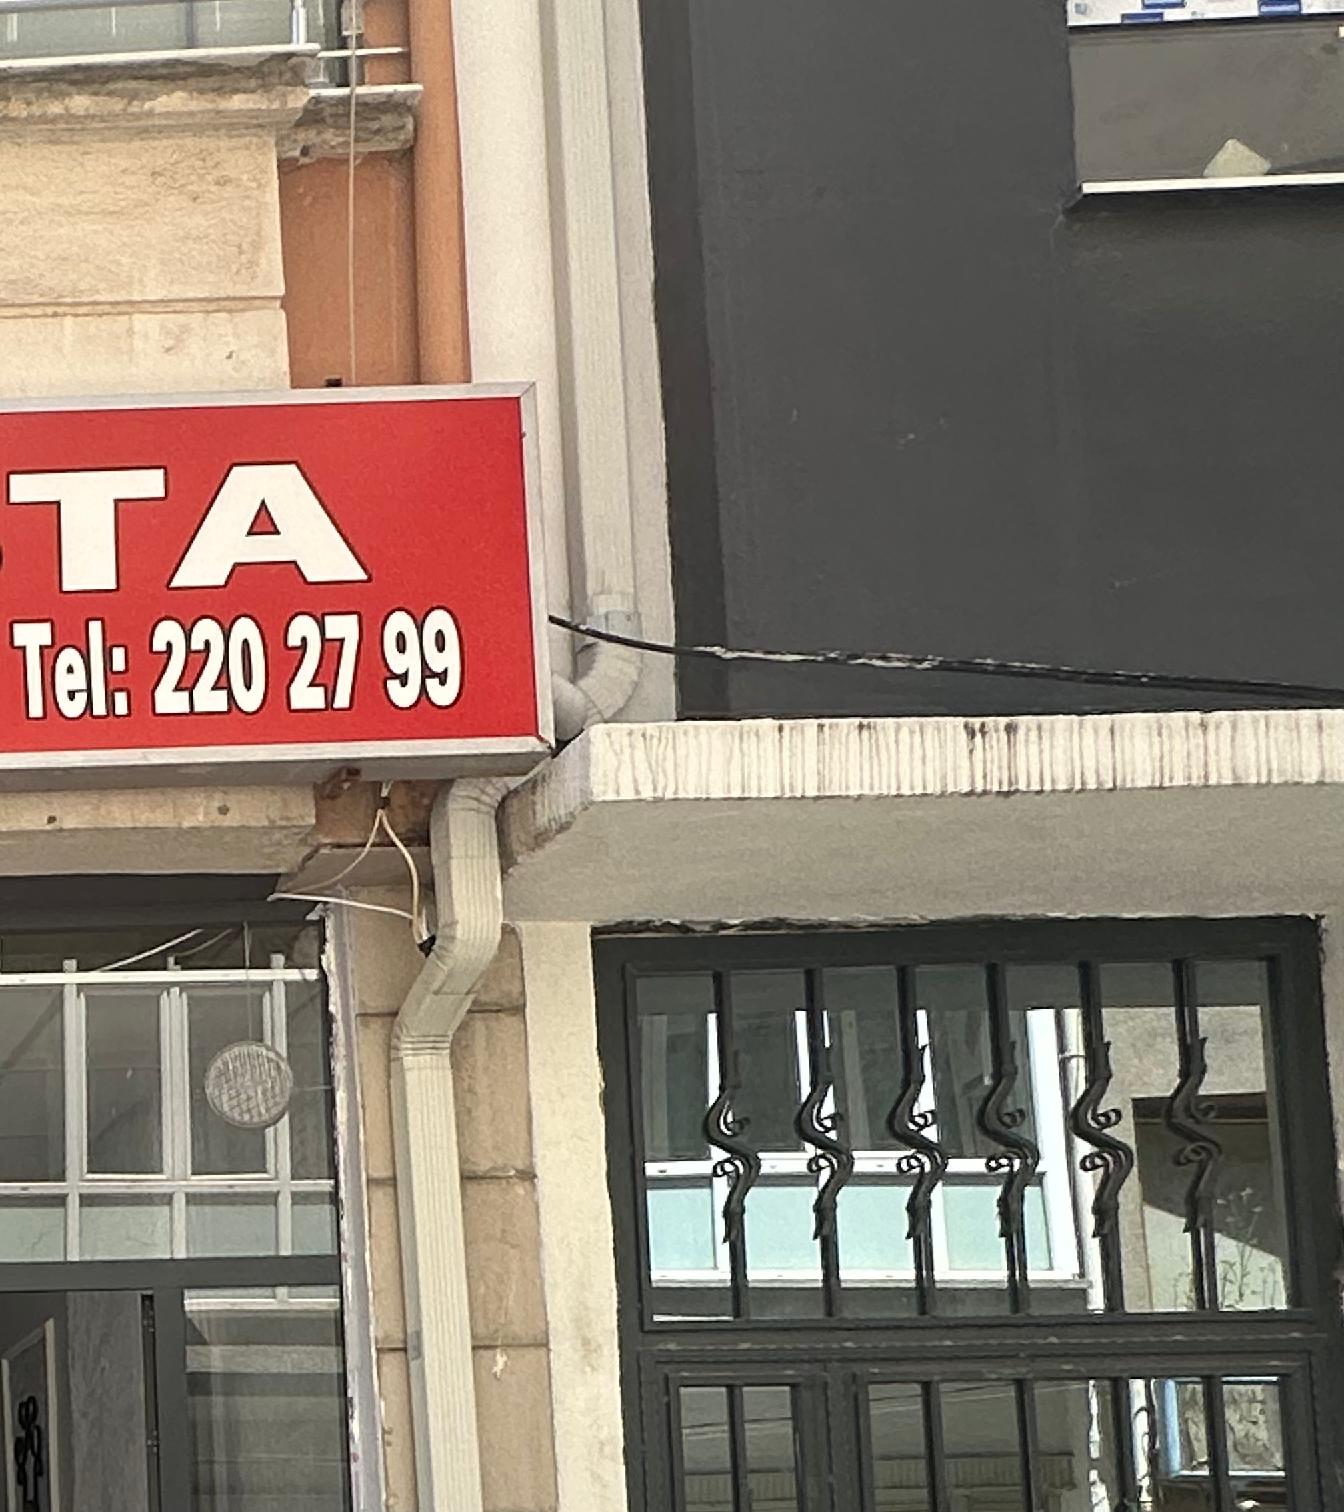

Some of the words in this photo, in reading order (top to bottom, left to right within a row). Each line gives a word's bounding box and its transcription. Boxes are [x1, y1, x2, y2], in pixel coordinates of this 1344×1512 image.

[10, 617, 130, 720] Tel:
[149, 613, 268, 717] 220
[285, 611, 362, 712] 27
[381, 606, 463, 710] 99
